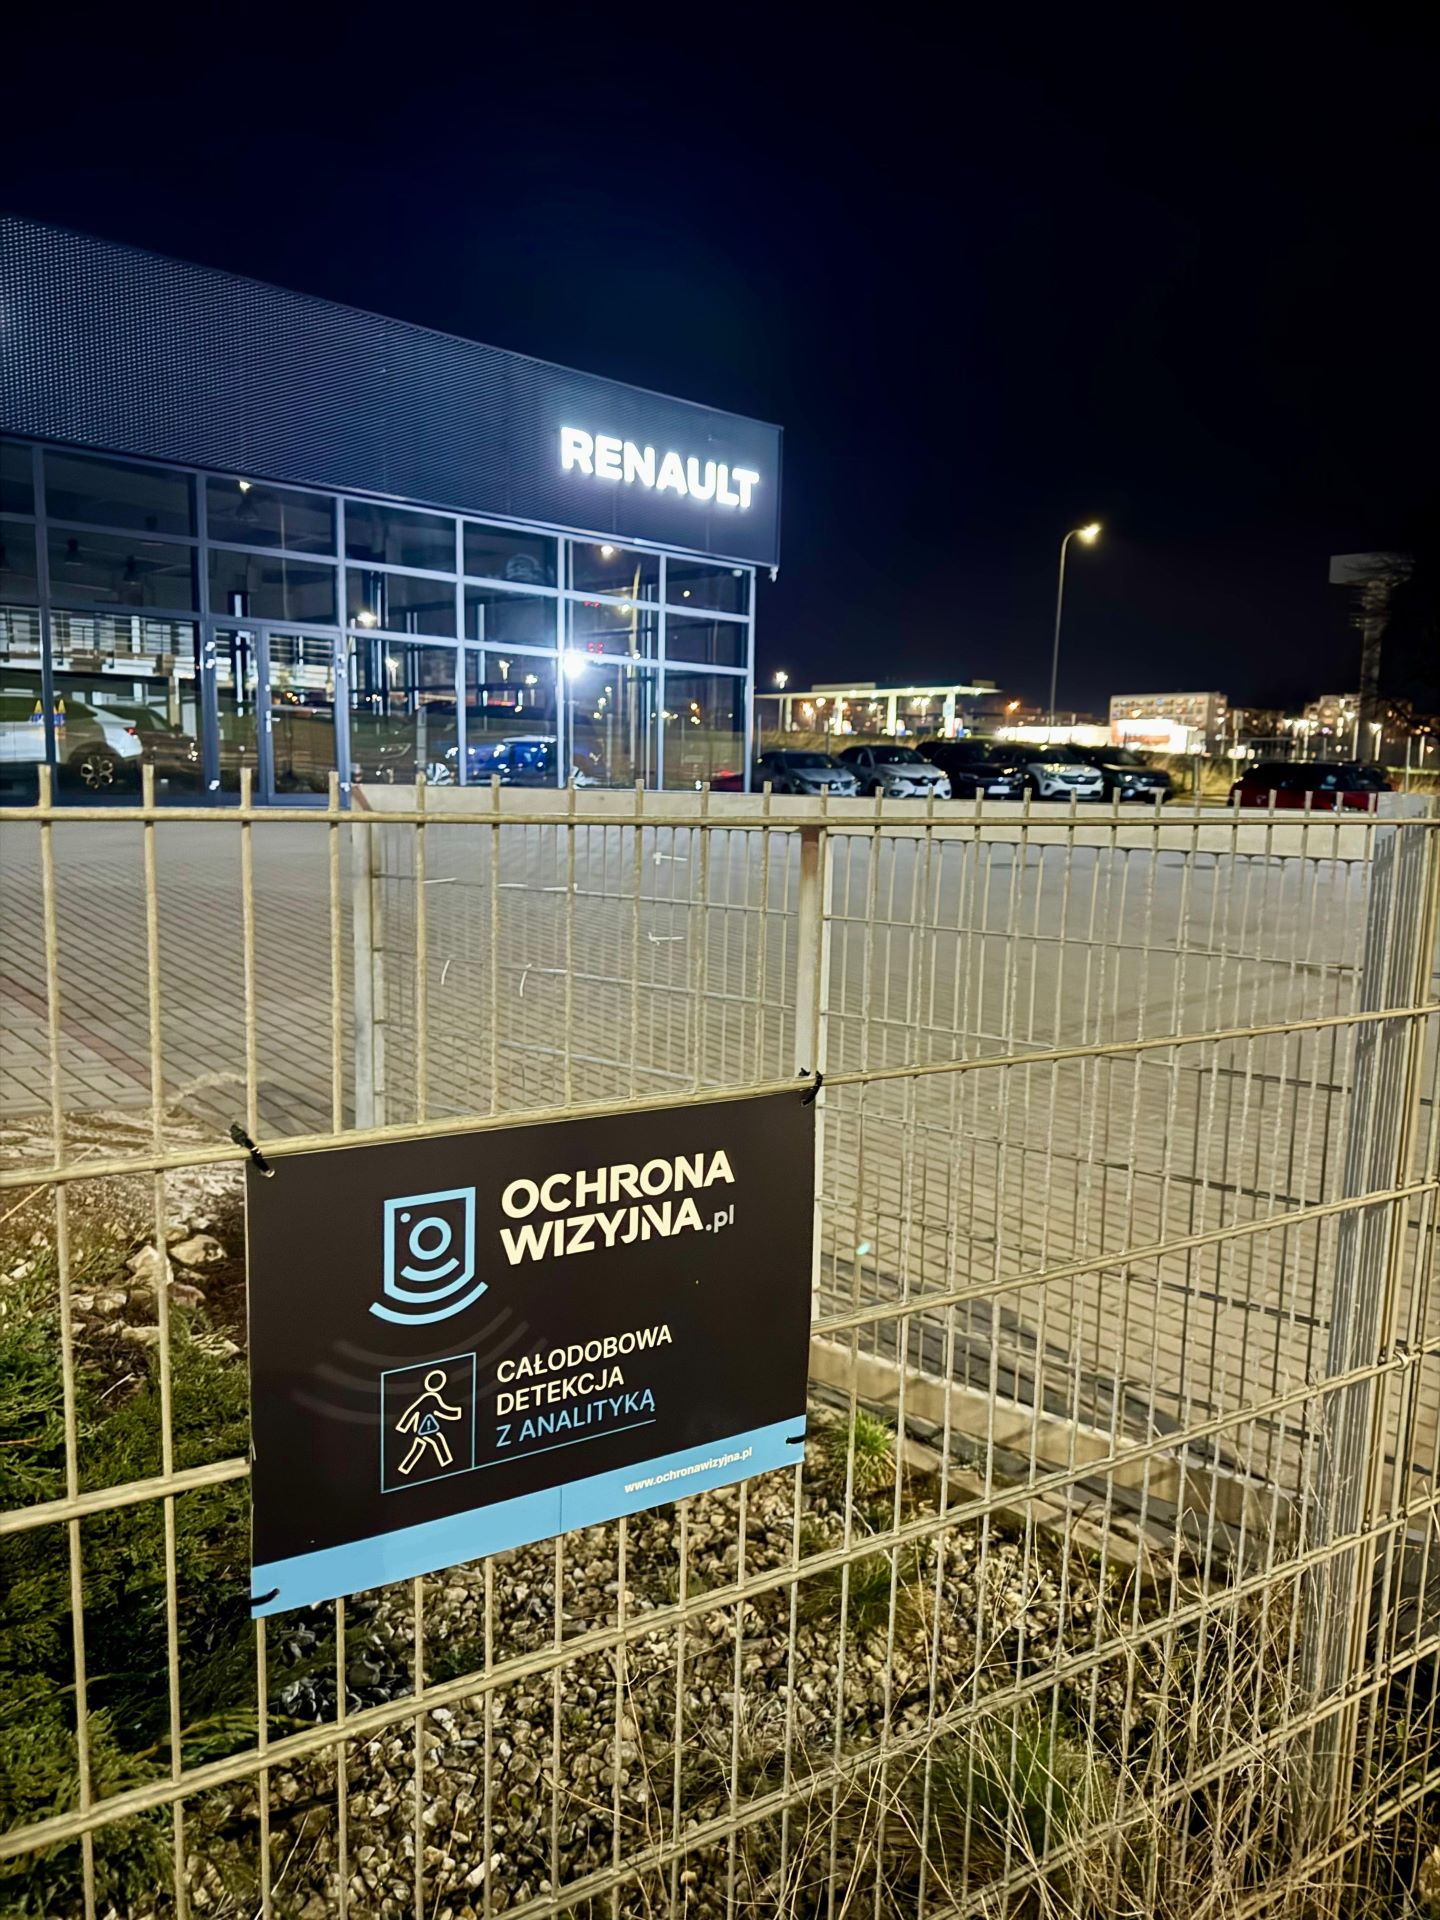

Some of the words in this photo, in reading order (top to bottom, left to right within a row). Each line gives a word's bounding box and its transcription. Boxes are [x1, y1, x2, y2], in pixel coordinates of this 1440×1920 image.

[560, 427, 760, 508] RENAULT
[501, 1150, 735, 1218] OCHRONA
[496, 1324, 673, 1383] CAŁODOBOWA
[496, 1366, 624, 1416] DETEKCJA
[496, 1424, 512, 1448] Z
[519, 1388, 656, 1442] ANALITYKĄ
[624, 1446, 753, 1494] www.ochronawizyjna.pl
